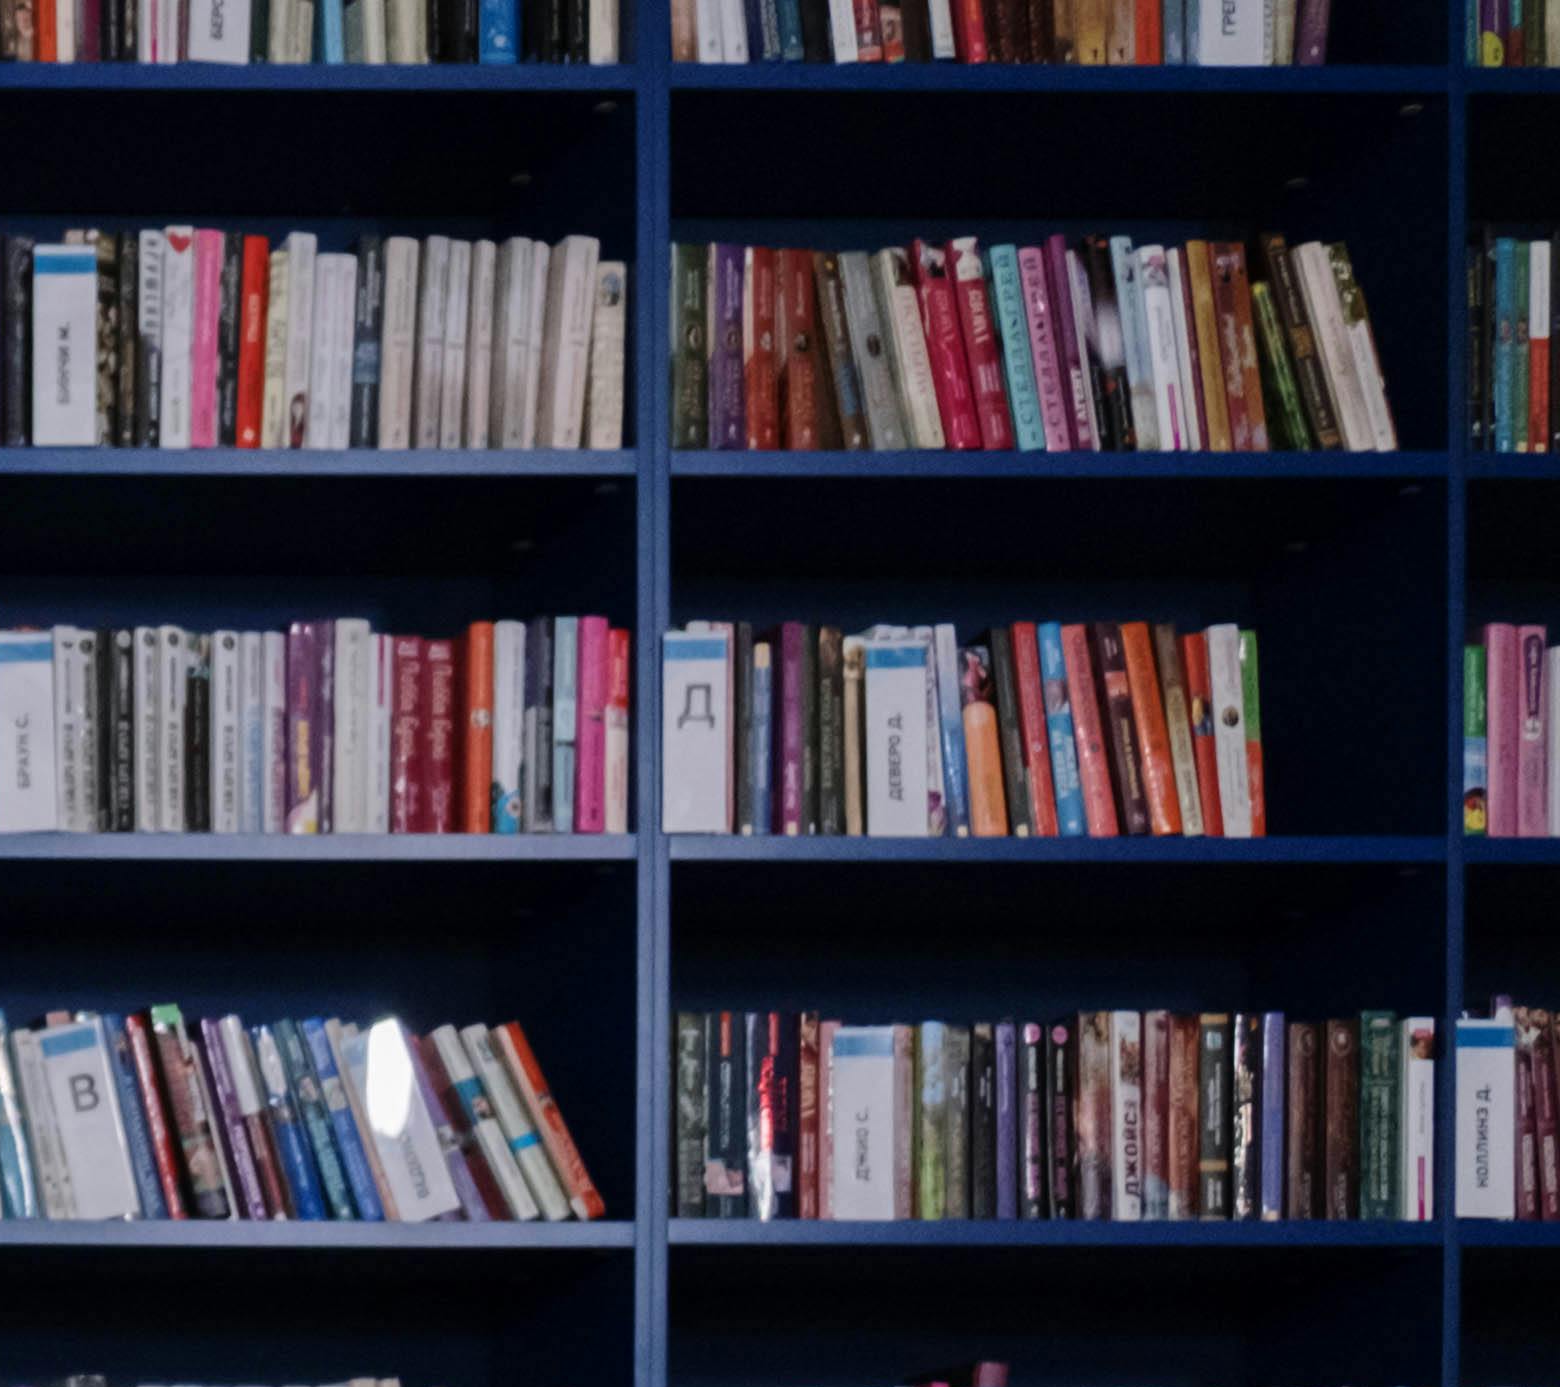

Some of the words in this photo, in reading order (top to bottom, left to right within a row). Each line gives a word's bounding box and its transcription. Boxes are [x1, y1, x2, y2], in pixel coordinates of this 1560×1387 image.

[676, 682, 716, 730] Д
[15, 732, 32, 790] БРАУН
[887, 734, 905, 802] ДЕВЕРО
[68, 1072, 101, 1113] В
[1475, 1106, 1490, 1189] КОЛЛИНЗ
